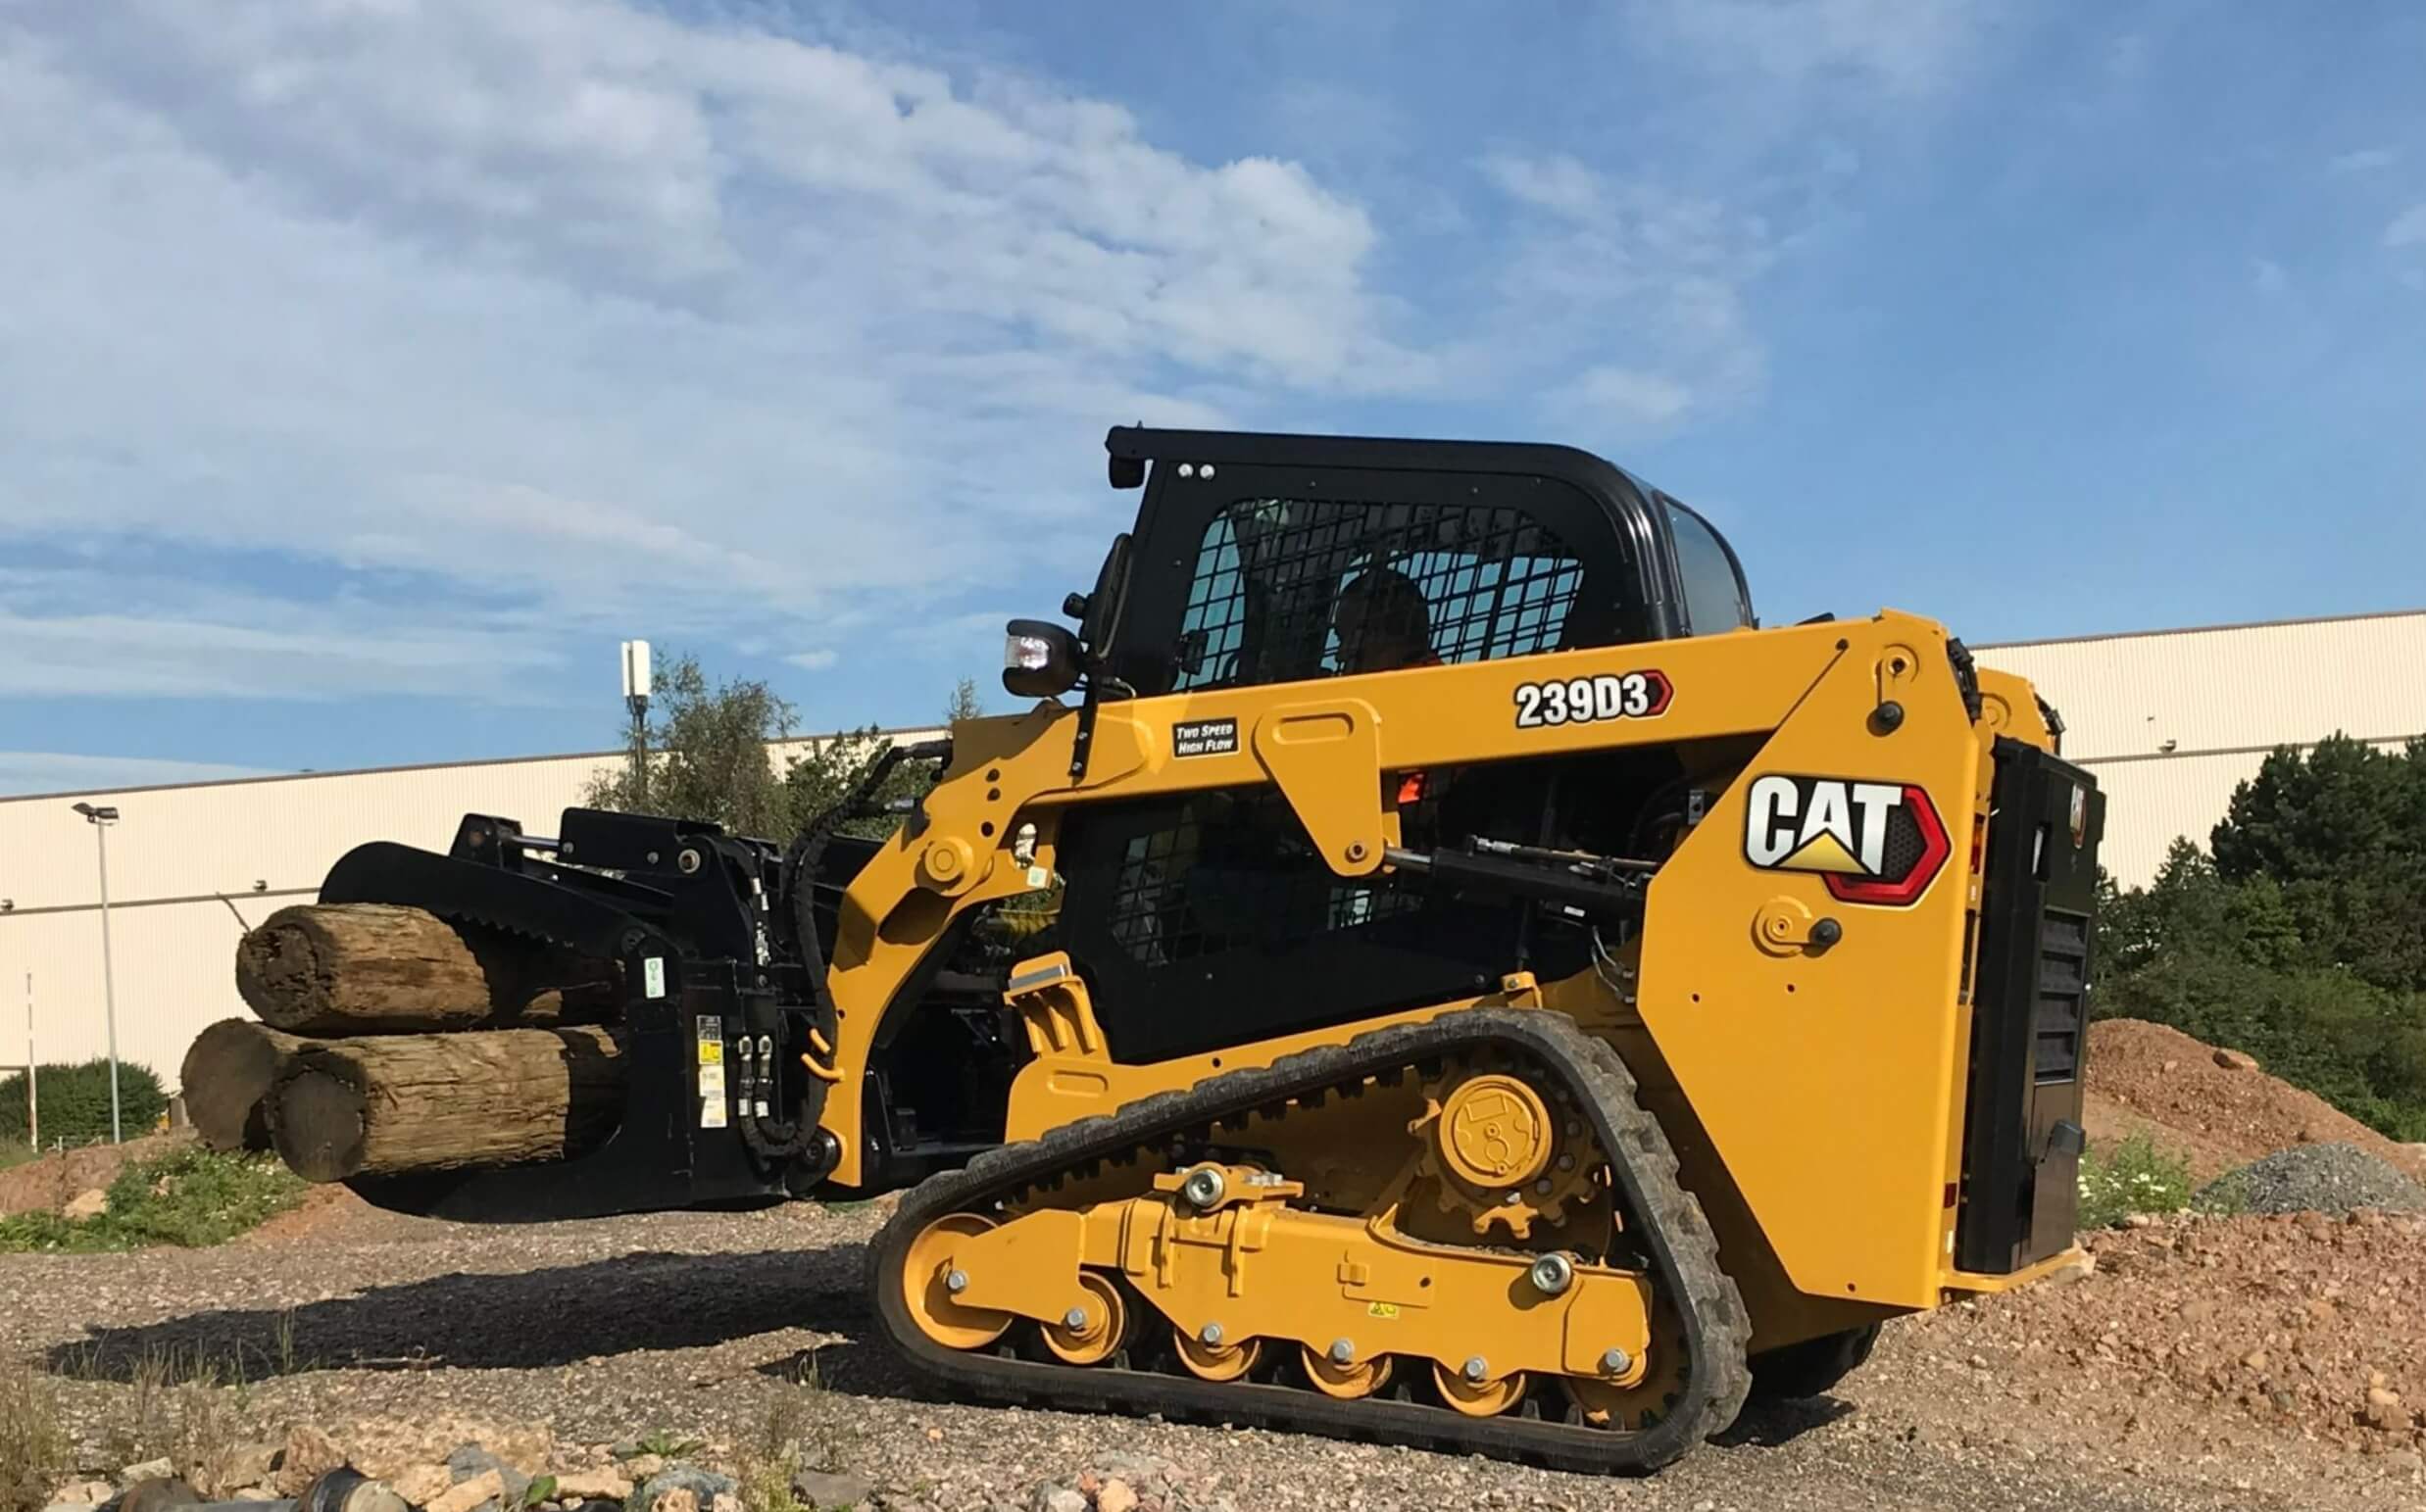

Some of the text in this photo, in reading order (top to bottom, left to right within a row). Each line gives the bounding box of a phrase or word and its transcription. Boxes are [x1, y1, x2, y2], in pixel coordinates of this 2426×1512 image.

[1516, 673, 1650, 726] 239D3
[1177, 724, 1234, 739] TWO SPEED
[1178, 739, 1233, 754] HIGH FLOW
[1747, 775, 1903, 875] CAT
